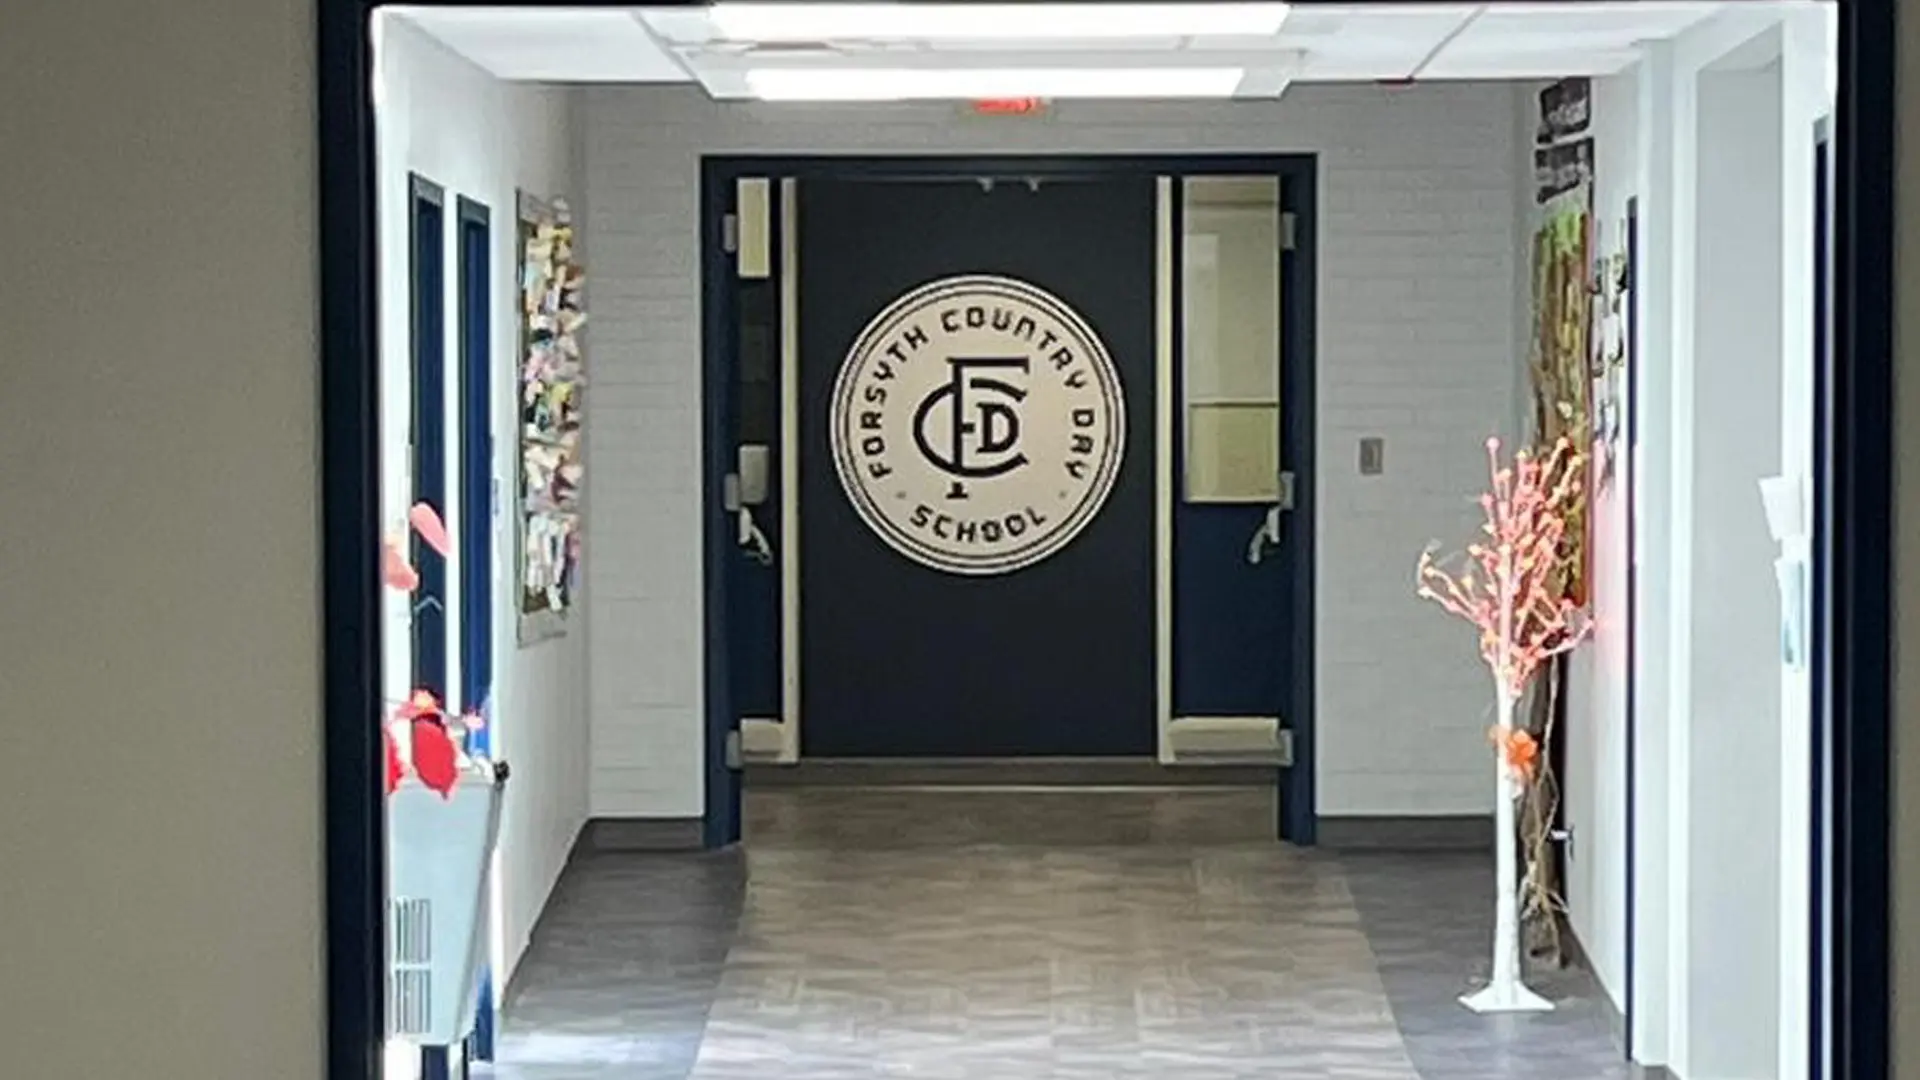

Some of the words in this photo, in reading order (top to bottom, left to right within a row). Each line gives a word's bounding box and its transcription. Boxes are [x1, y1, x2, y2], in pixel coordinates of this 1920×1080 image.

[860, 325, 930, 479] FORSYTH
[940, 306, 1088, 390] COUNTRY
[1064, 408, 1095, 480] DAY
[909, 504, 1048, 543] SCHOOL
